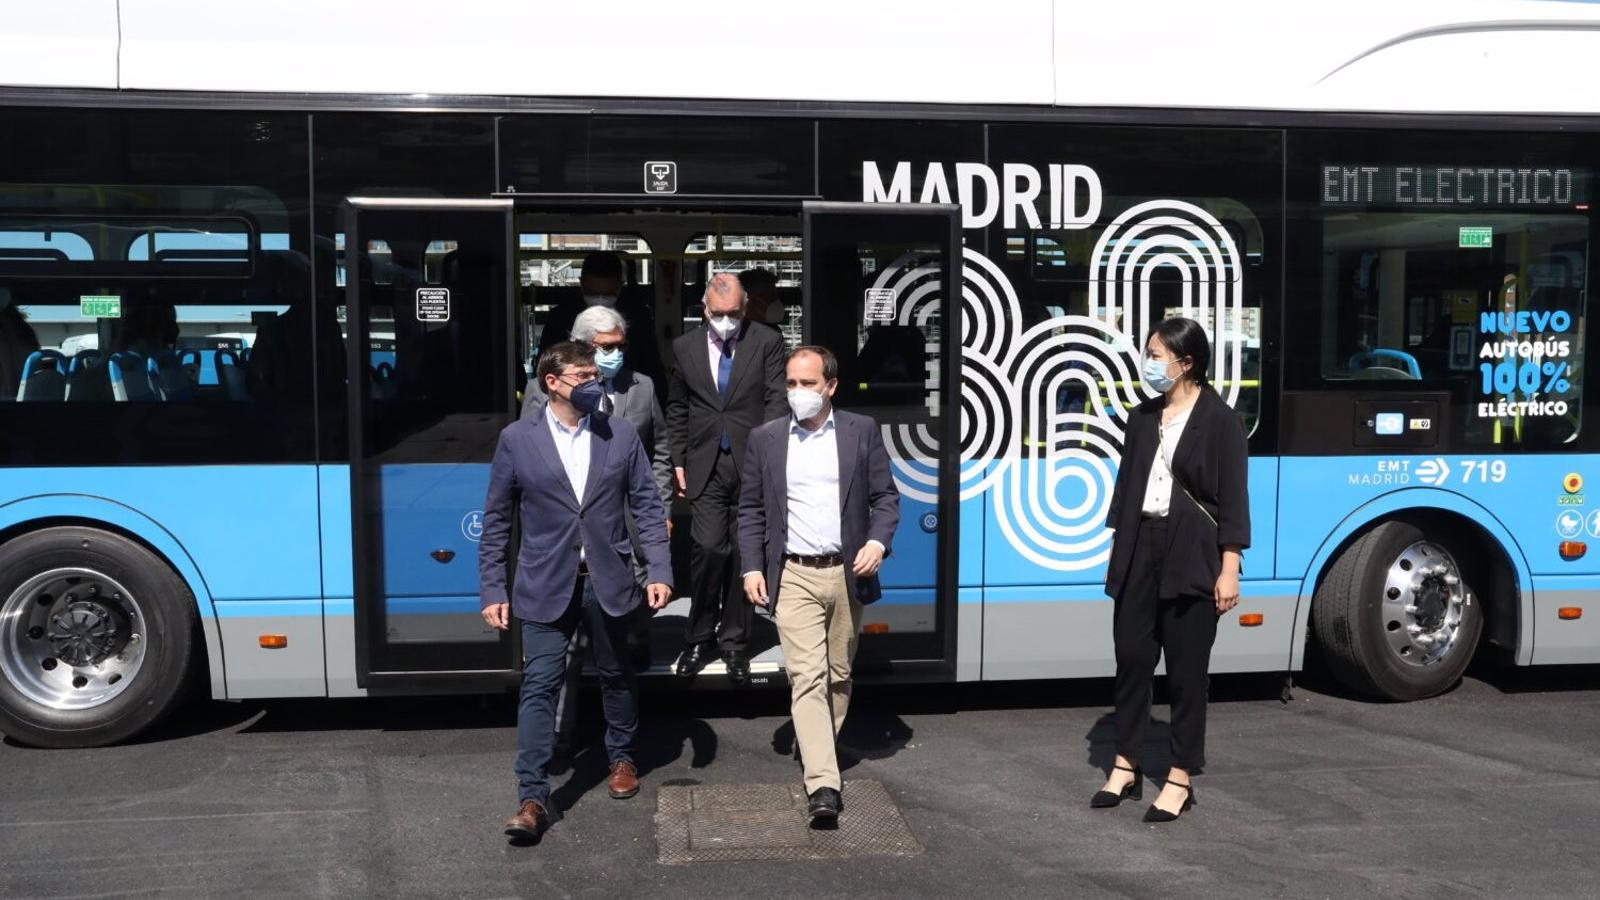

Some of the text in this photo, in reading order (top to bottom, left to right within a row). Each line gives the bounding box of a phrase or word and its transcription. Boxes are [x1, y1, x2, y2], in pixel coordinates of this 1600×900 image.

[862, 161, 1103, 229] MADRID
[1324, 166, 1572, 204] EMT ELECTRICO
[1481, 310, 1571, 333] NUEVO
[1480, 336, 1570, 358] AUTOBÚS
[1480, 361, 1569, 394] 100%
[1478, 398, 1568, 417] ELÉCTRICO
[1378, 460, 1411, 472] EMT
[1460, 460, 1507, 484] 719
[1348, 474, 1411, 485] MADRID
